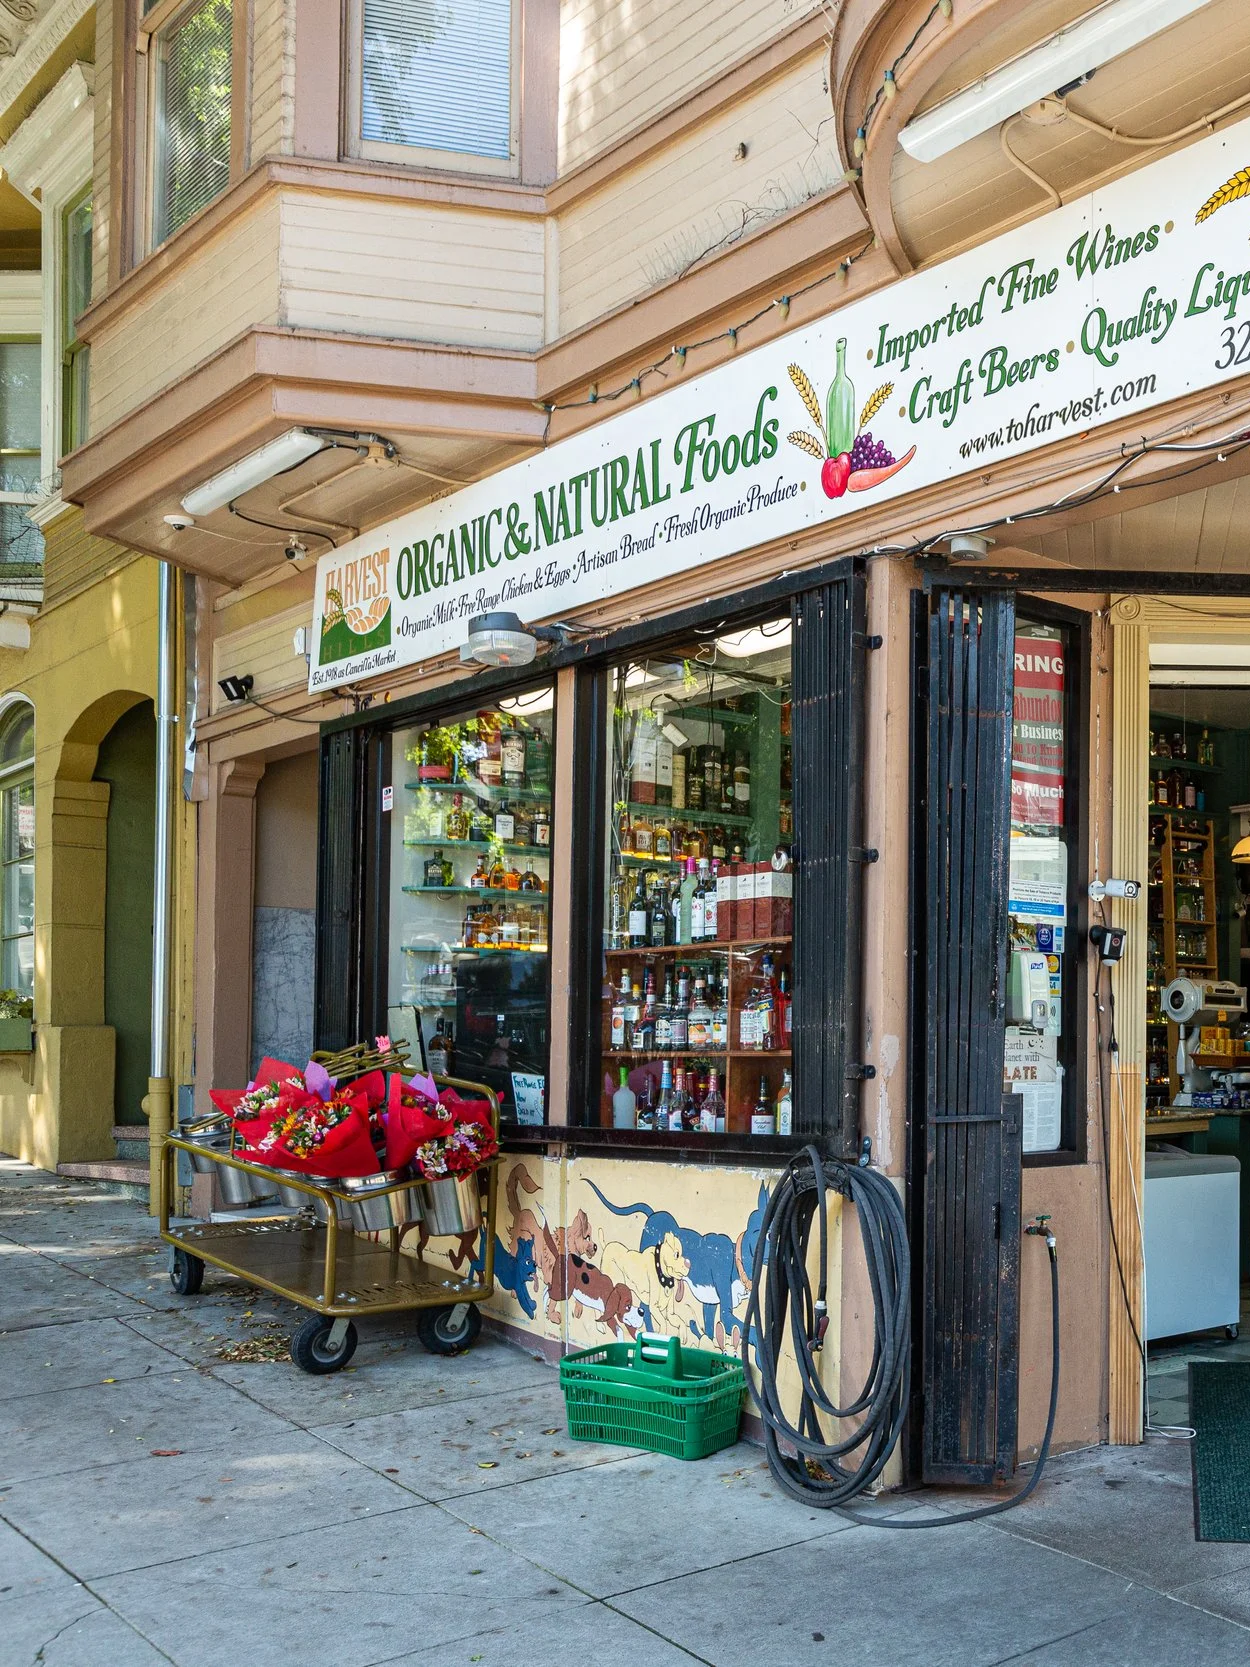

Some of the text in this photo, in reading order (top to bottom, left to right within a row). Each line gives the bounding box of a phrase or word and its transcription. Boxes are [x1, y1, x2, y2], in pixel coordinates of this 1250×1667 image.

[874, 224, 1160, 372] Imported Fine Wines
[908, 358, 974, 428] Craft
[978, 345, 1060, 397] Beers
[1080, 286, 1177, 367] Quality
[959, 373, 1157, 459] www.toharvest.com
[397, 386, 779, 600] ORGANIC & NATURAL Foods
[323, 547, 390, 616] HARVEST
[402, 614, 433, 638] Organic
[433, 598, 455, 627] Milk
[458, 594, 475, 617] Free
[476, 588, 500, 613] Range
[502, 573, 533, 602] Chicken
[544, 560, 571, 587] Eggs
[573, 550, 618, 583] Artisan
[620, 523, 658, 559] Bread
[664, 506, 700, 543] Fresh
[700, 499, 746, 531] Organic
[747, 476, 798, 514] Produce
[323, 627, 386, 661] HILLS
[372, 650, 396, 668] Market
[1014, 654, 1063, 675] RING
[1004, 1066, 1037, 1080] LATE
[1005, 1051, 1039, 1061] lanet with
